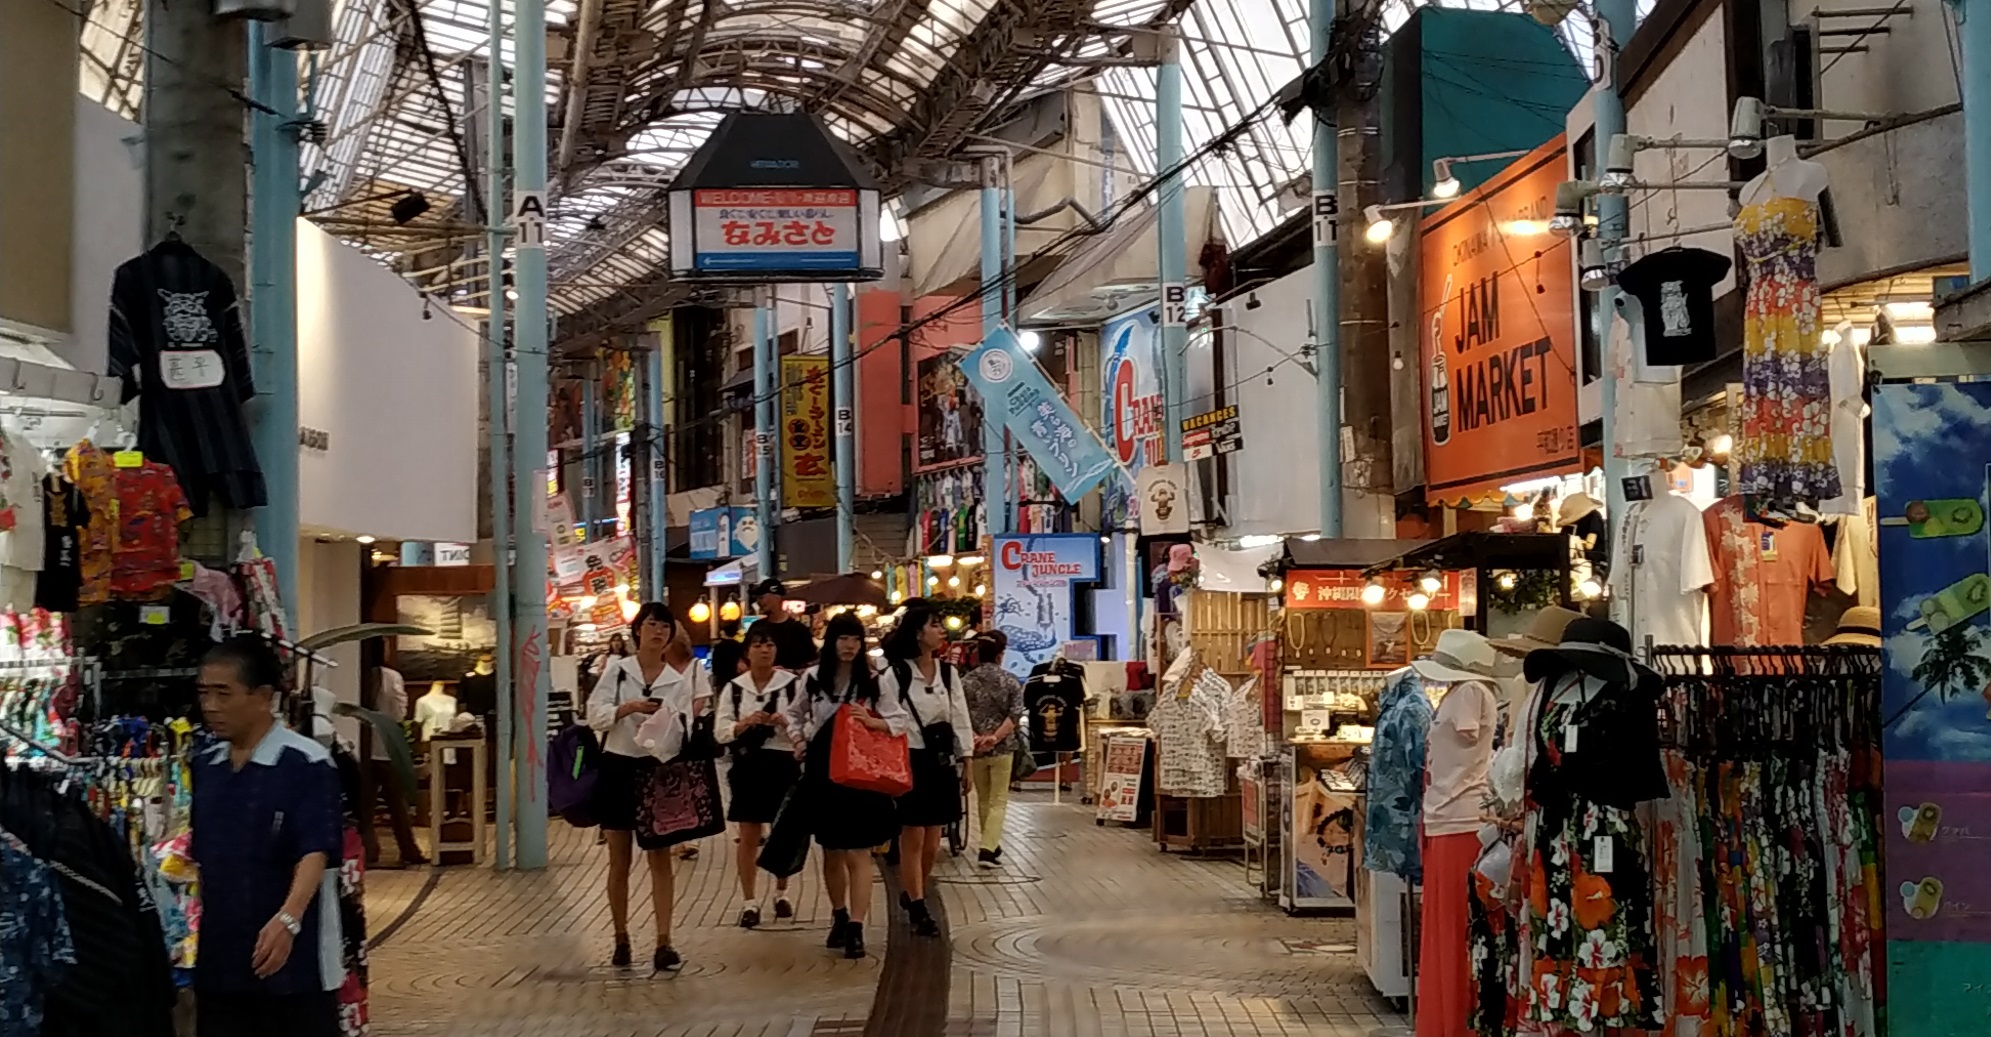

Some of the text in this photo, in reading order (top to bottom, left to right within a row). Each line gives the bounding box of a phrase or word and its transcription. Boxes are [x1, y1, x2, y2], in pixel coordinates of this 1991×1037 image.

[517, 195, 546, 218] A
[701, 191, 769, 204] WELCOME
[1315, 195, 1339, 215] B
[519, 221, 543, 244] 11
[721, 220, 836, 246] なみさと
[1315, 219, 1339, 242] 11
[1166, 286, 1185, 303] B
[1166, 306, 1186, 323] 12
[1455, 270, 1501, 355] JAM
[1457, 335, 1552, 434] MARKET
[1182, 406, 1236, 431] VACANCES
[1001, 541, 1056, 571] CRANE
